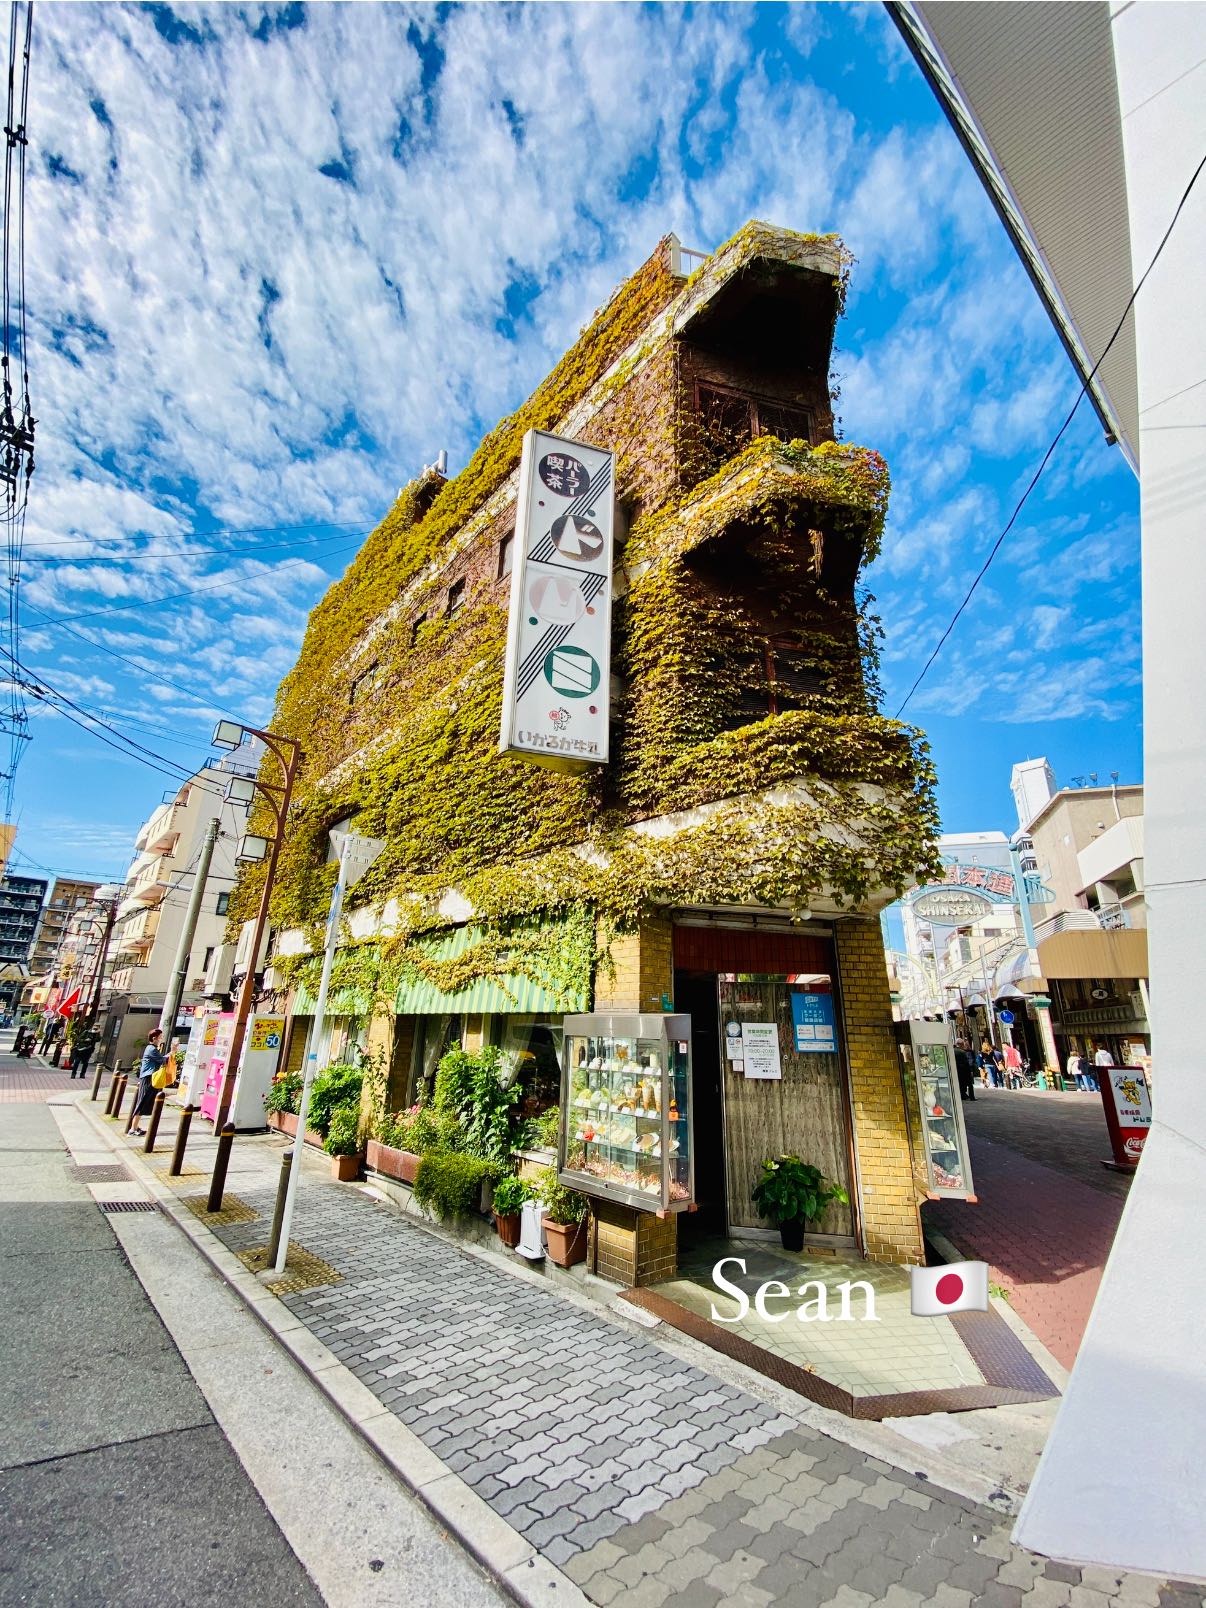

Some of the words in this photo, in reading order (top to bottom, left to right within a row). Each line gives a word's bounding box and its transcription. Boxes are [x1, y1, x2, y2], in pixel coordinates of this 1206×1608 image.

[546, 455, 564, 489] 喫茶
[566, 460, 582, 496] パーラー
[929, 893, 970, 903] OSAKA
[918, 903, 986, 916] SHINSEKAI
[265, 1035, 280, 1047] 50
